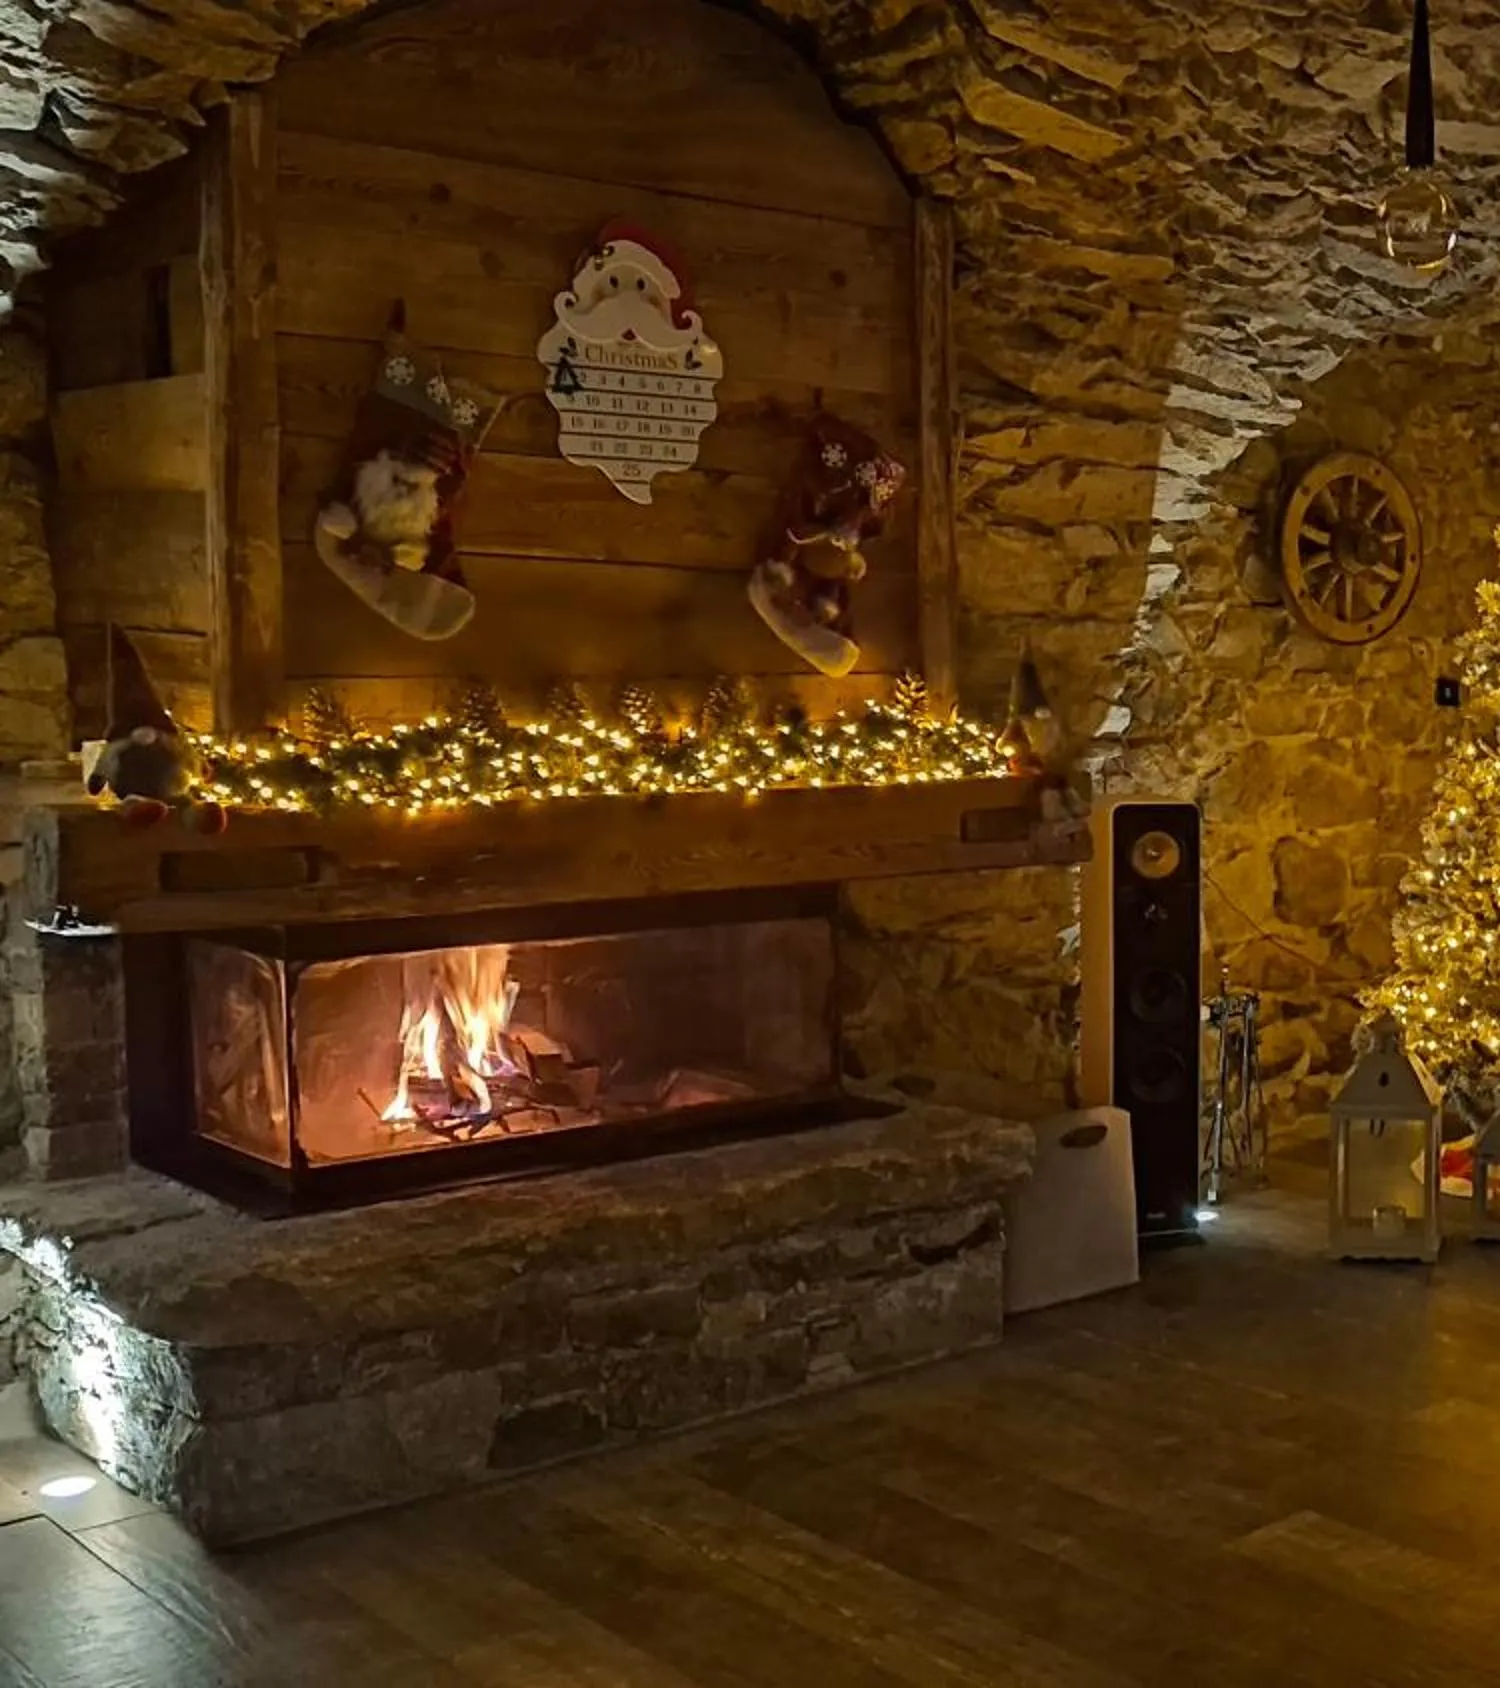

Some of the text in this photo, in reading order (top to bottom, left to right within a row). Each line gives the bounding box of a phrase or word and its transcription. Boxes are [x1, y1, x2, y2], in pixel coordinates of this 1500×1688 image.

[618, 375, 625, 388] 4
[676, 381, 683, 392] 7
[586, 394, 600, 407] 10
[612, 396, 623, 409] 11
[636, 398, 649, 412] 12
[661, 401, 673, 414] 13
[684, 404, 697, 416] 14
[616, 419, 630, 432] 17
[637, 421, 651, 434] 18
[659, 422, 672, 435] 19
[614, 441, 628, 454] 22
[621, 463, 642, 477] 25
